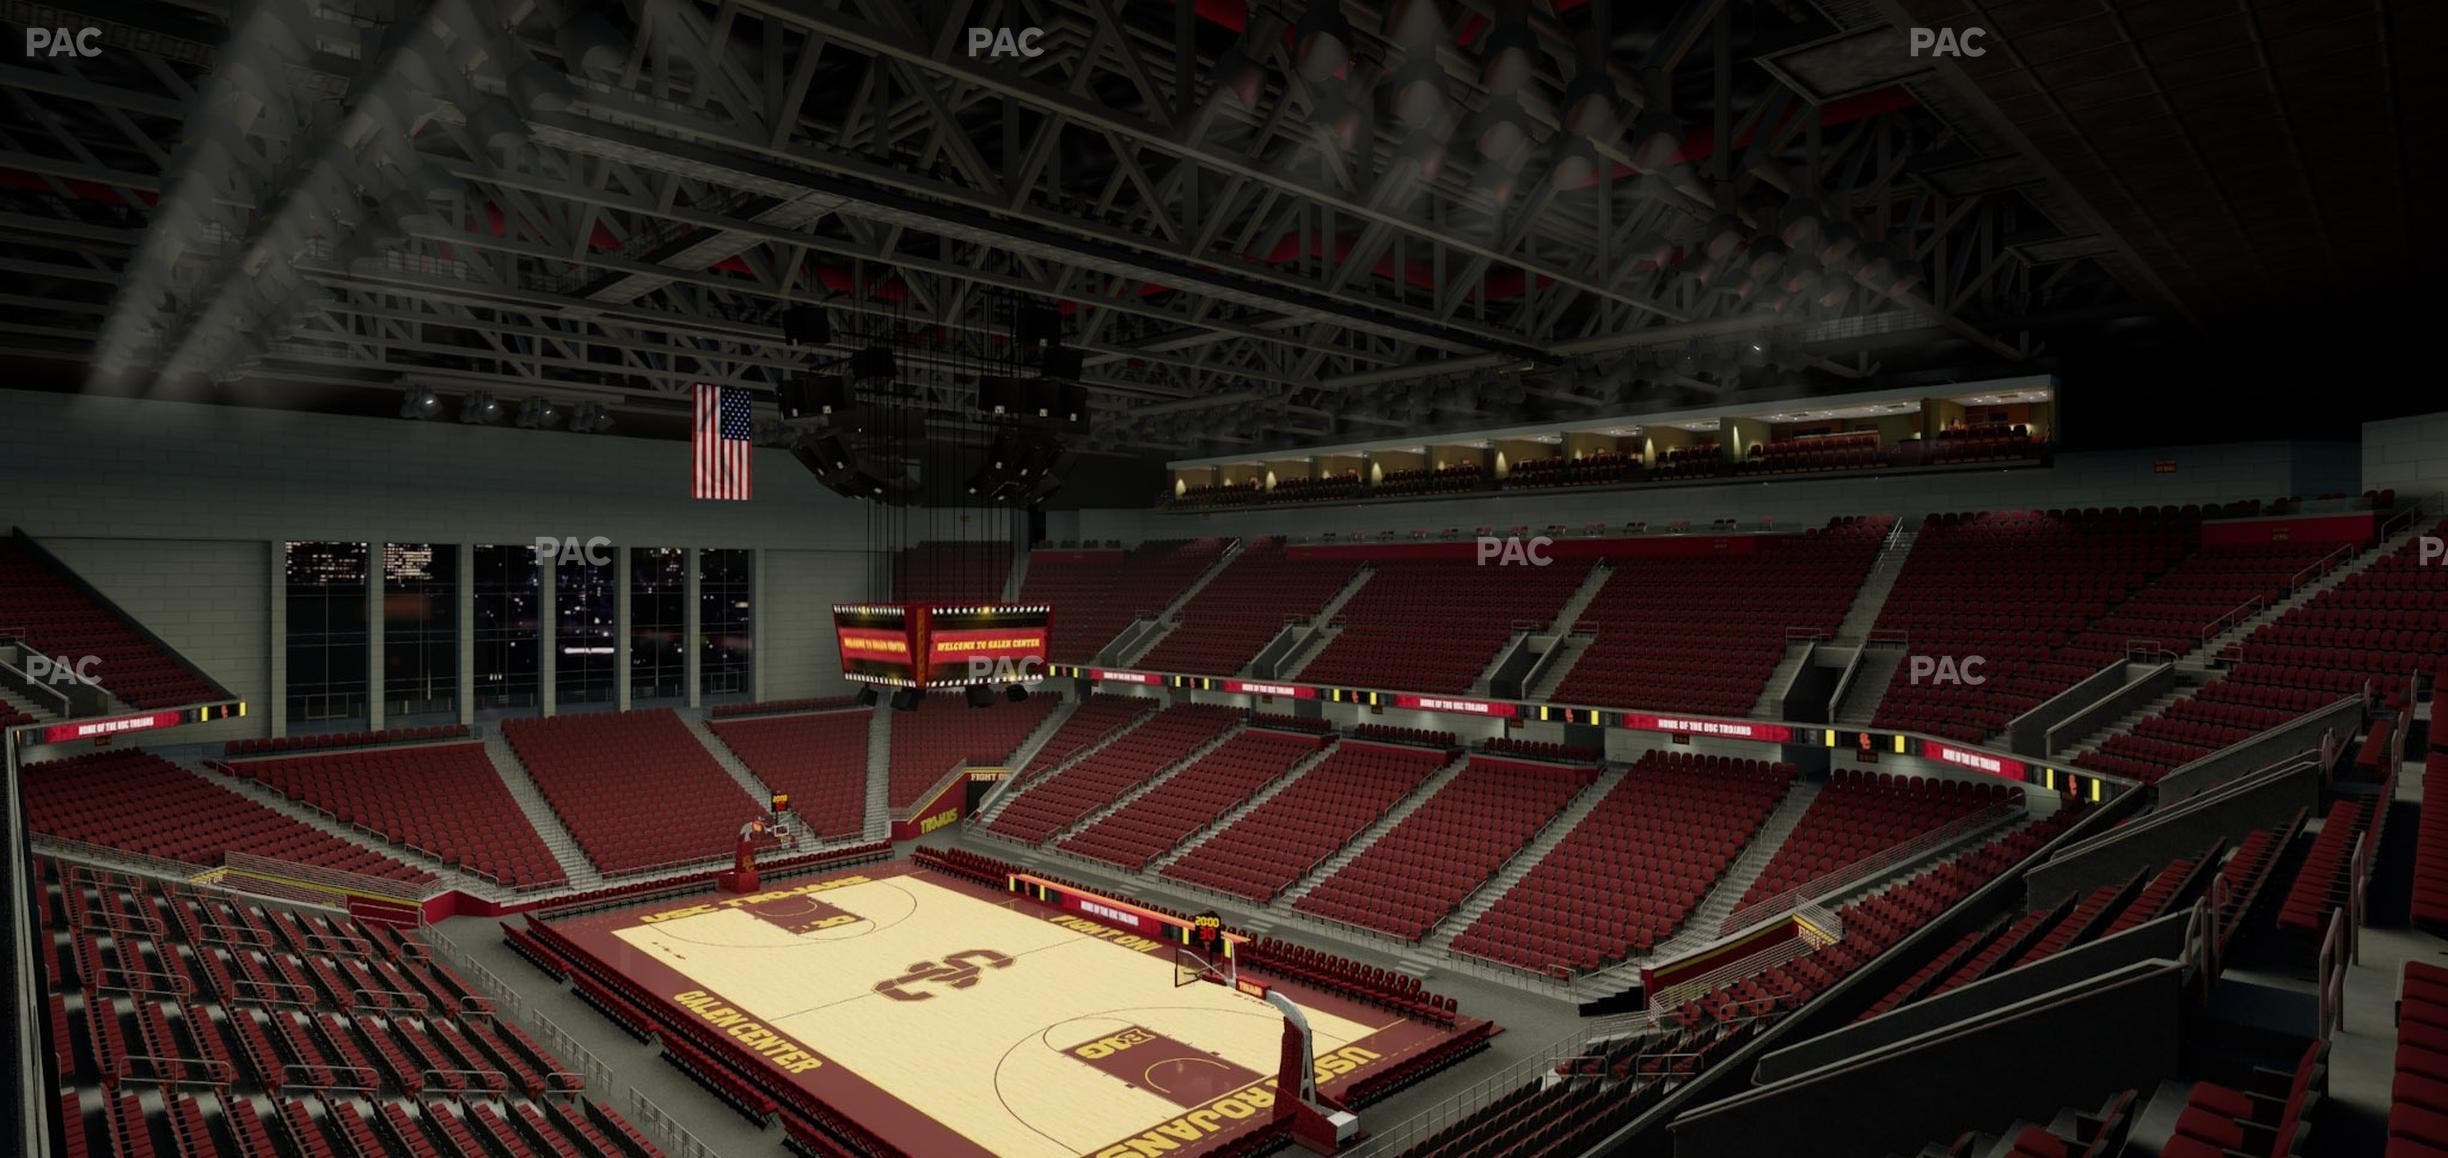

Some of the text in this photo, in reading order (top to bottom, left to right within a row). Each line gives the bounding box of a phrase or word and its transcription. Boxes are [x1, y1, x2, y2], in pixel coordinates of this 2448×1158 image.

[1659, 720, 1751, 735] HOME OF THE USC TROJANS
[970, 773, 996, 782] FIGHT
[920, 808, 958, 834] TROJANS
[1195, 916, 1220, 928] 20:00
[1049, 914, 1164, 953] FIGHT ON
[673, 990, 824, 1074] GALEN CENTER
